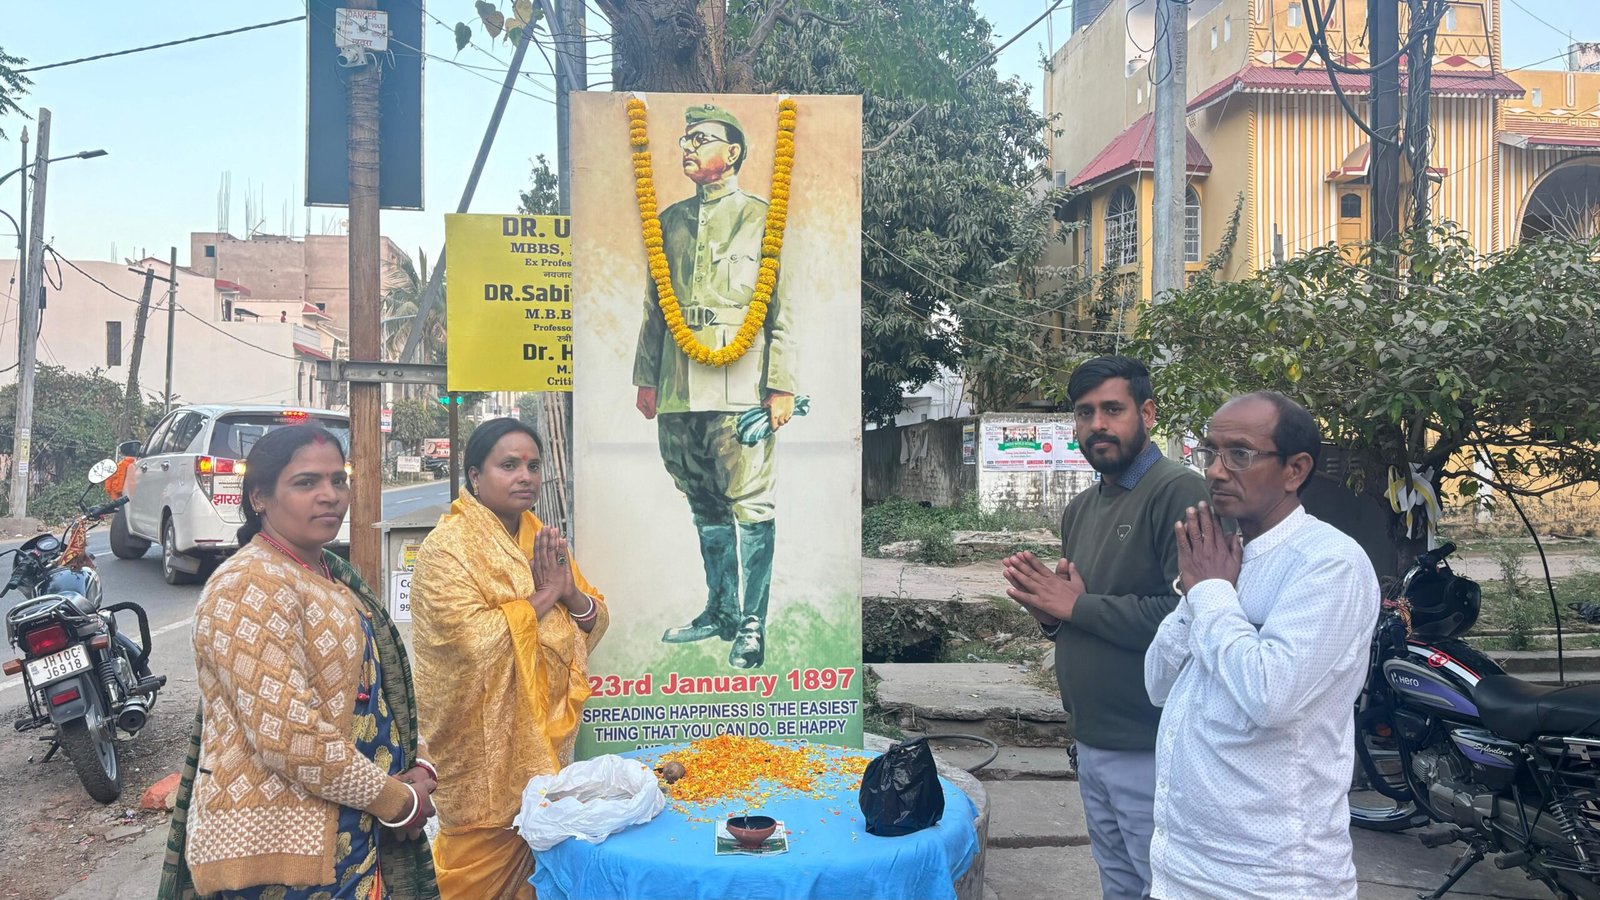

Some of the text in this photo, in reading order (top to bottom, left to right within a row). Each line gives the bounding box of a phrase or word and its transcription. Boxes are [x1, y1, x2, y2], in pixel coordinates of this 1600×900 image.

[347, 10, 377, 20] DANGER
[502, 217, 546, 238] DR.
[510, 242, 564, 256] MBBS,
[525, 258, 538, 266] Ex
[523, 343, 555, 361] Dr.
[43, 647, 79, 669] JH10C
[46, 658, 82, 680] J6918
[588, 668, 855, 698] 23rd January 1897
[582, 700, 858, 723] SPREADING HAPPINESS IS THE EASIEST
[594, 719, 847, 742] THING THAT YOU CAN DO. BE HAPPY
